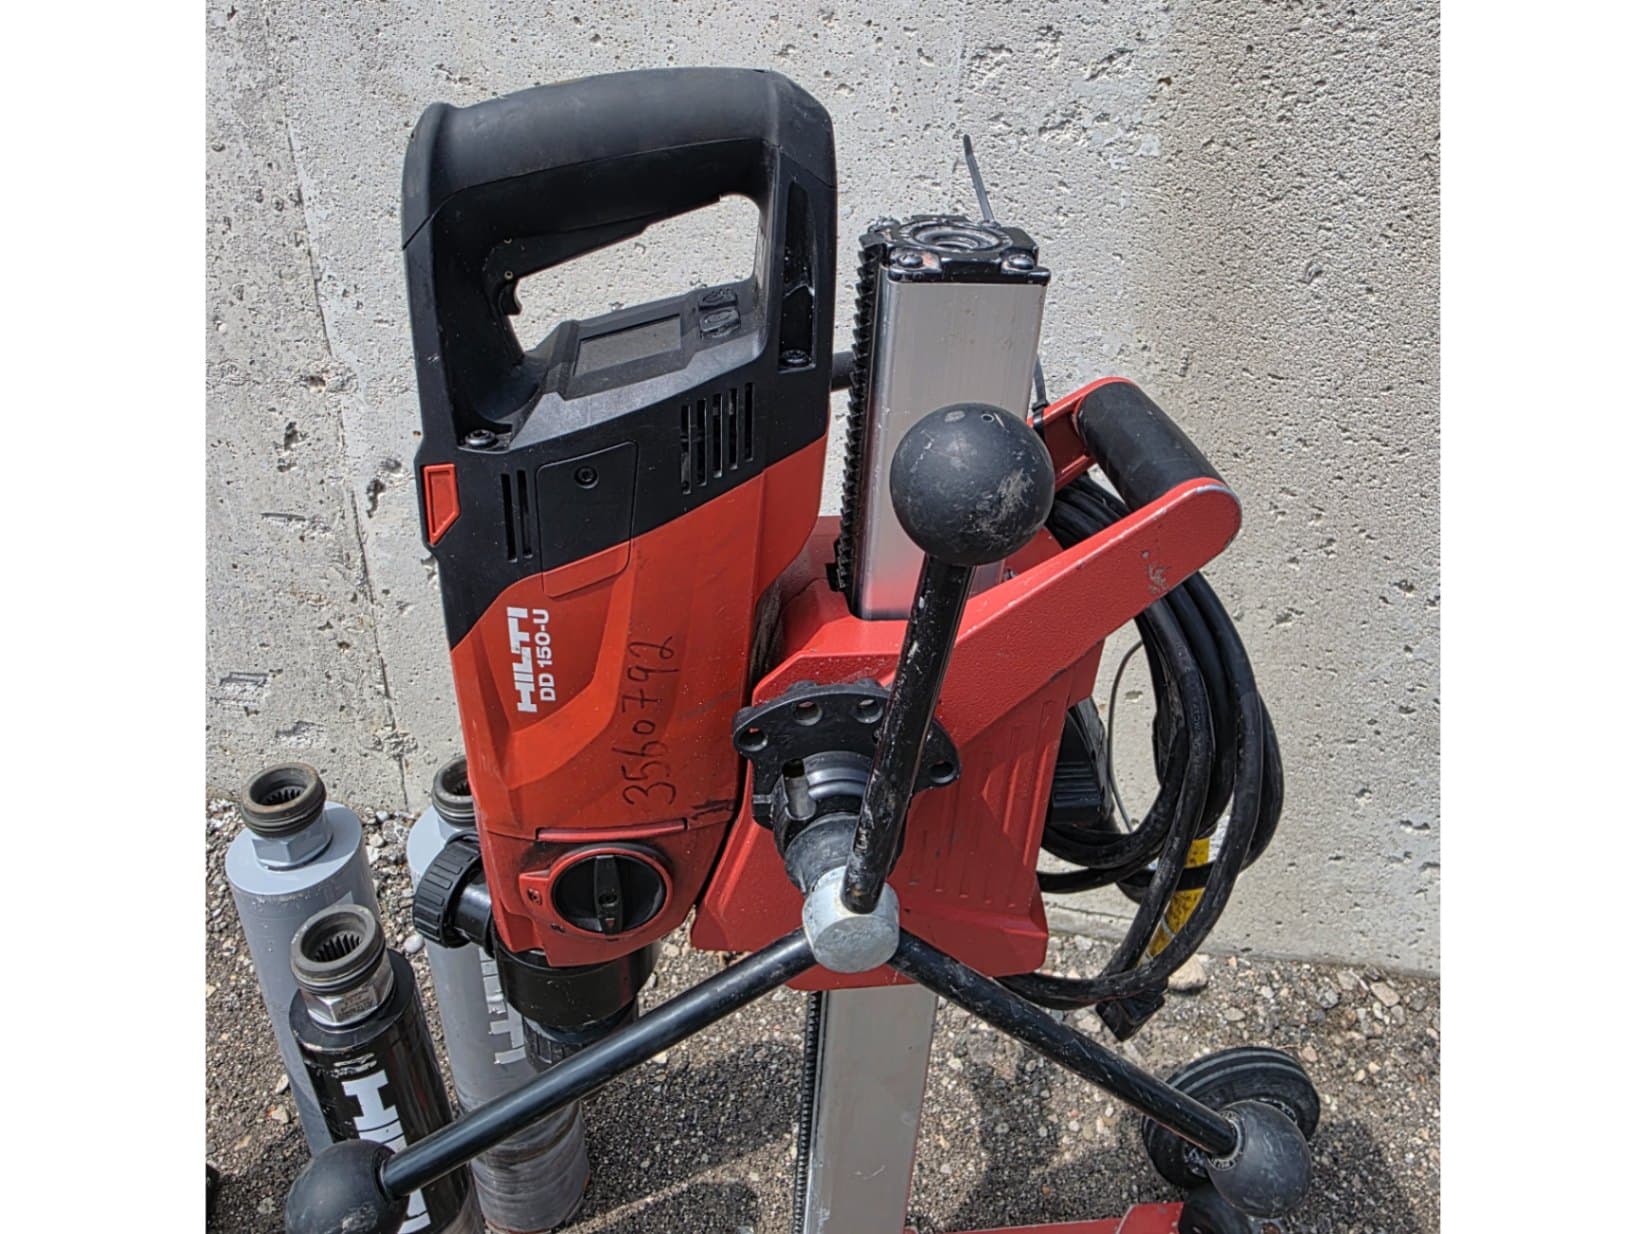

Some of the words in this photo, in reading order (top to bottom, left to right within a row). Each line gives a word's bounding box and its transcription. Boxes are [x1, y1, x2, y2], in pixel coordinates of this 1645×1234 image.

[507, 607, 537, 712] HILTI
[532, 608, 553, 668] 150-U
[538, 672, 556, 701] DD
[611, 636, 681, 805] 3560792
[479, 947, 527, 1064] ILTI
[341, 1069, 431, 1234] HII
